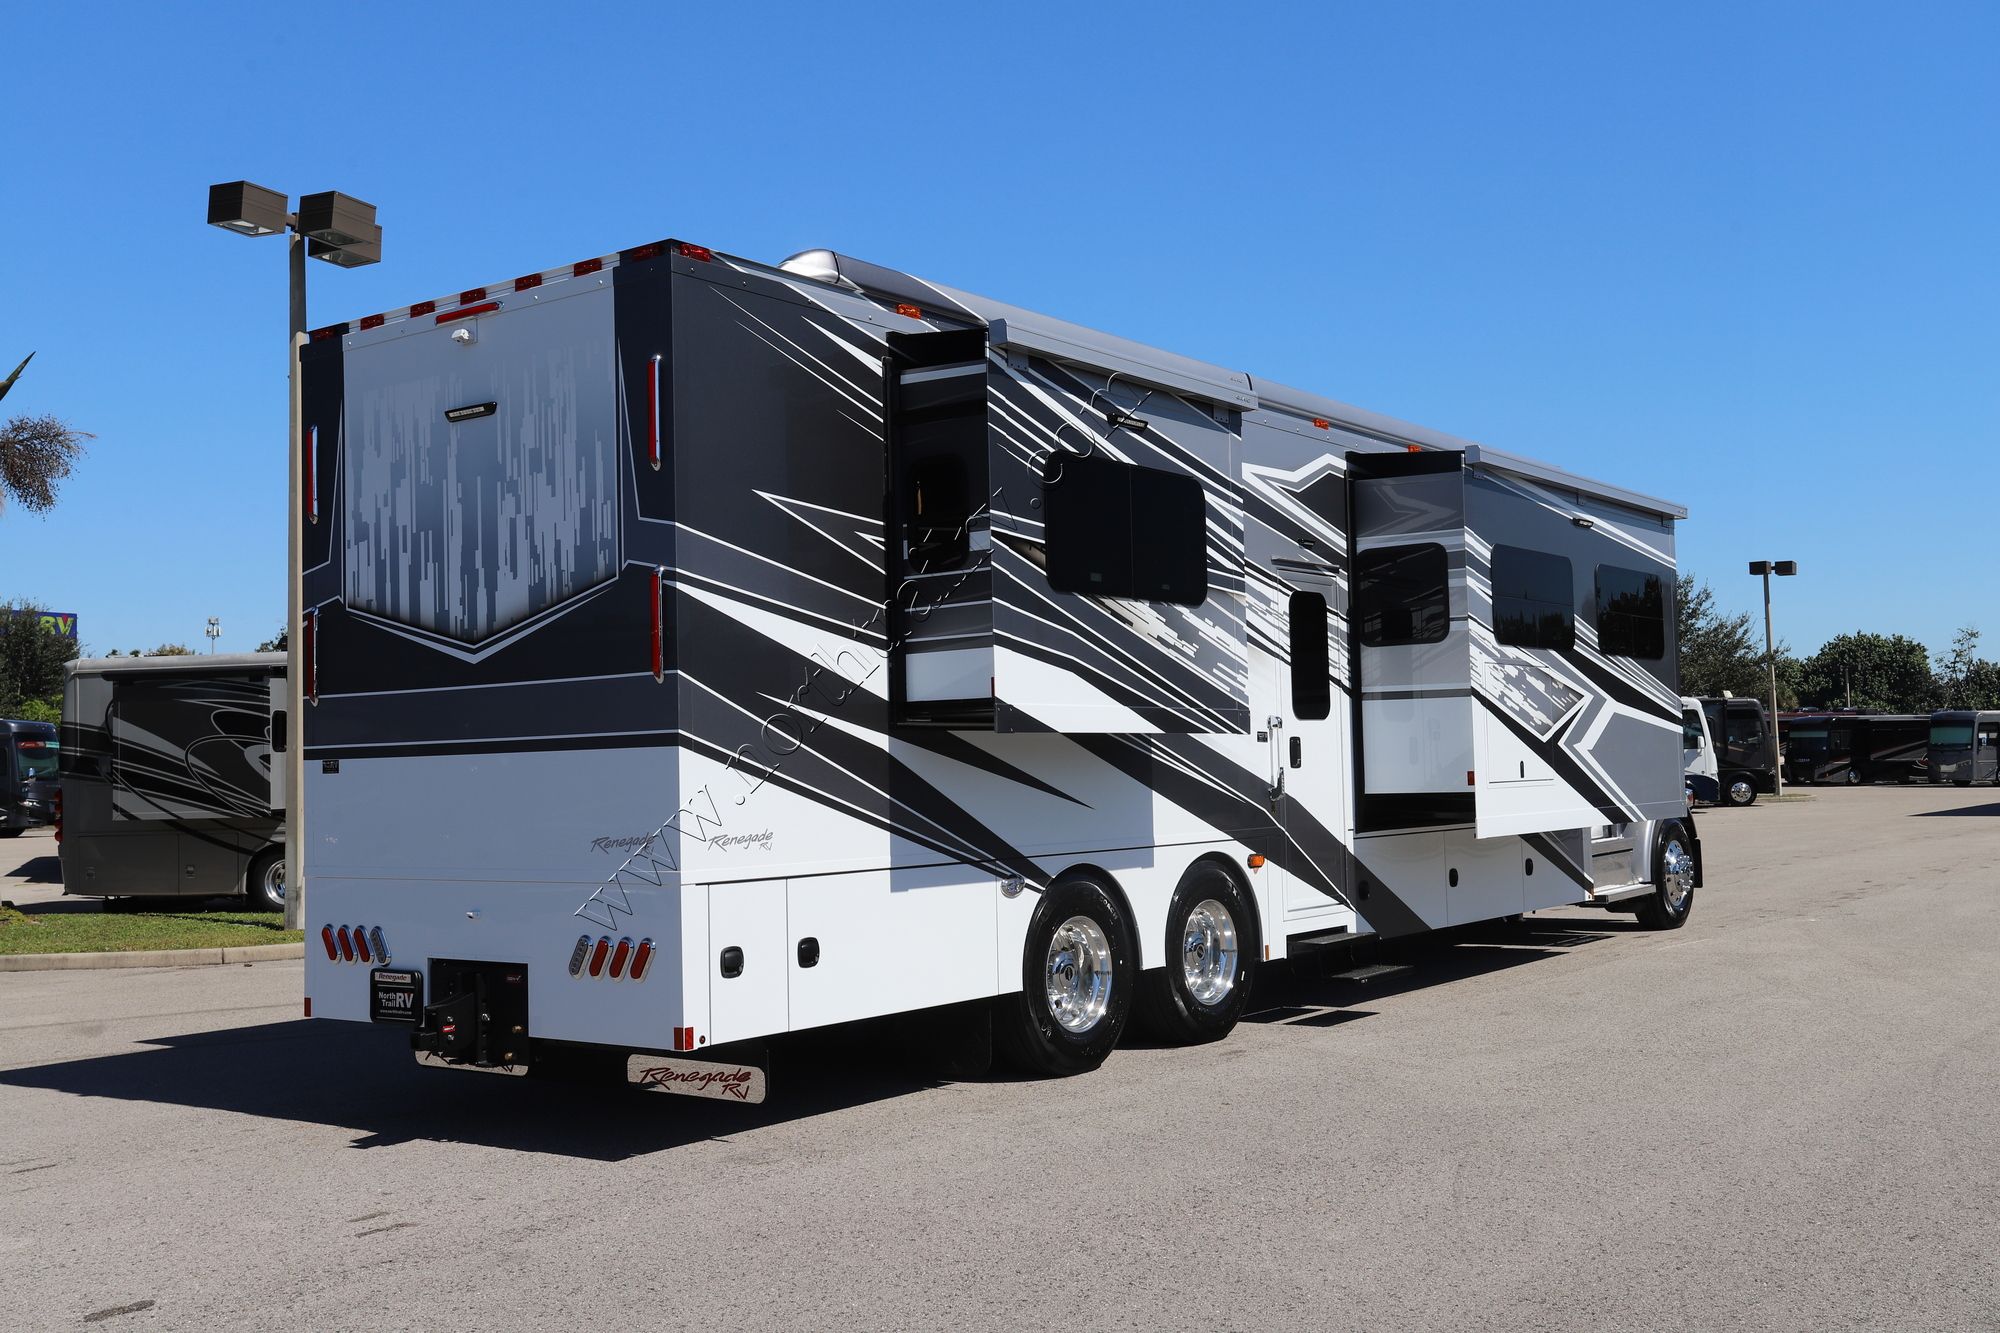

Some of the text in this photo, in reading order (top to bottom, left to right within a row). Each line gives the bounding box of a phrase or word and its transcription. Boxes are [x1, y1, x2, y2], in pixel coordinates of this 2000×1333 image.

[40, 615, 75, 635] RV
[591, 832, 655, 854] Renegade
[708, 828, 774, 852] Renegade
[758, 842, 773, 851] RV
[379, 991, 396, 1000] North
[396, 992, 414, 1009] RV
[640, 1067, 751, 1091] Renegade
[721, 1083, 750, 1100] RV
